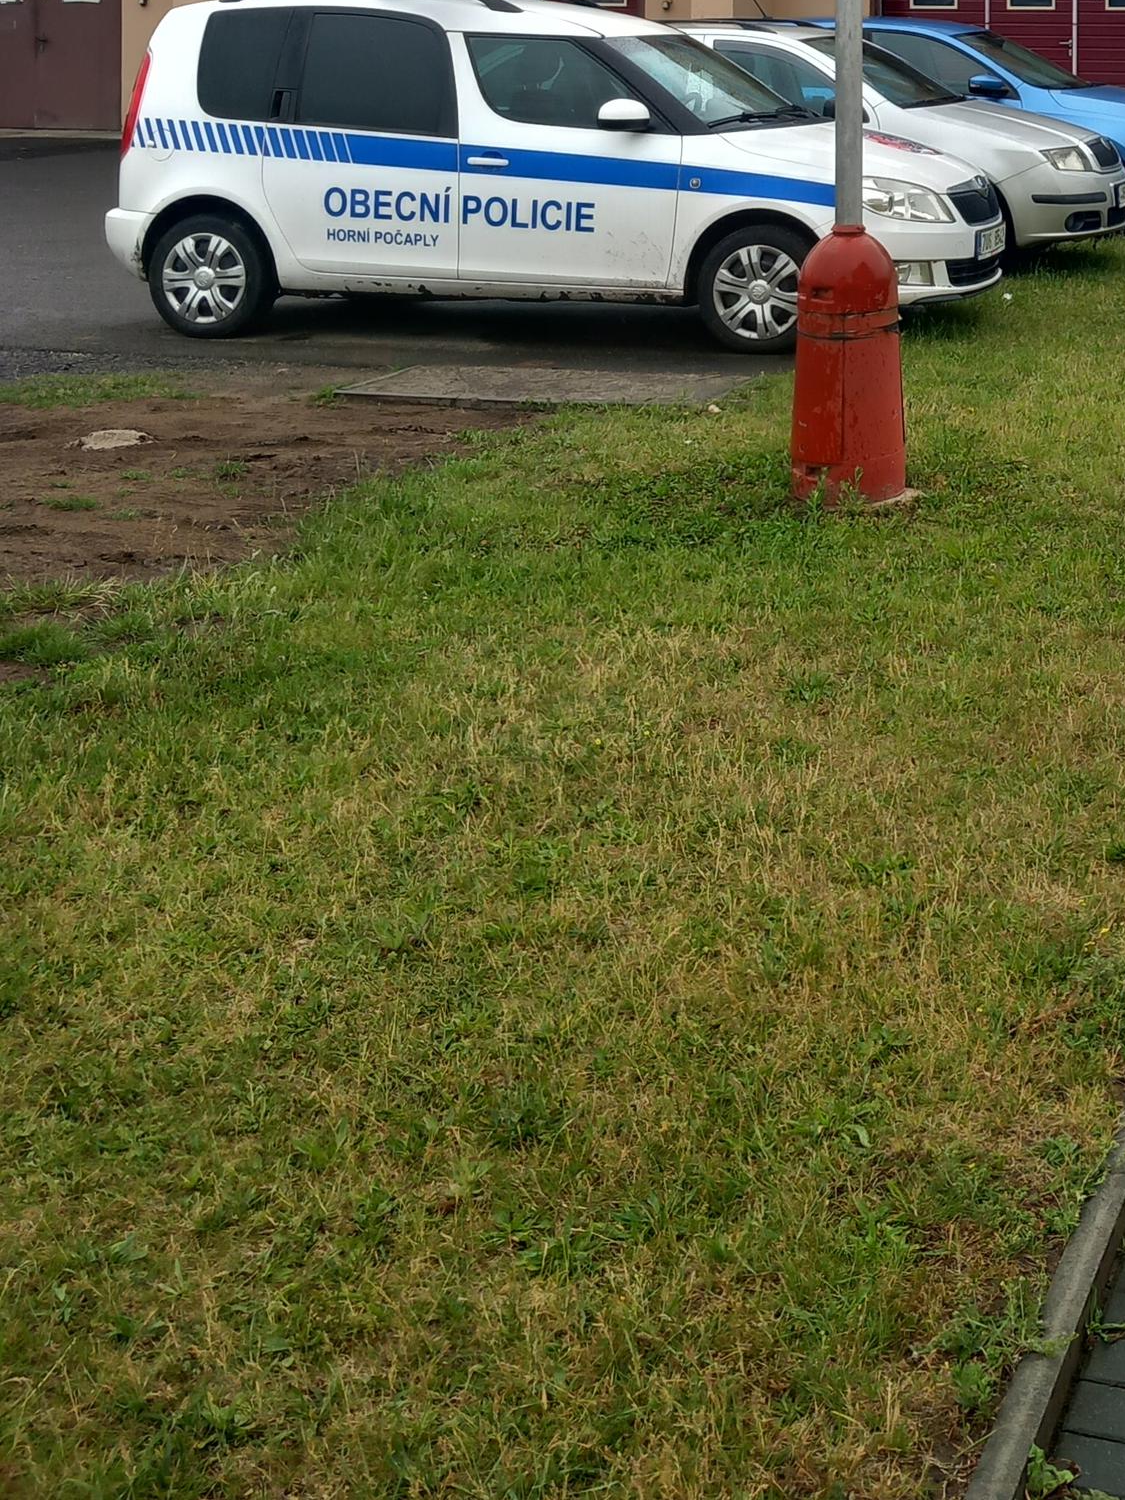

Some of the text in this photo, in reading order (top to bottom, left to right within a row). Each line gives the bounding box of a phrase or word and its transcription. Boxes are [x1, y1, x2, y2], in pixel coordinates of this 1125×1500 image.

[324, 186, 595, 233] OBECNÍ POLICIE
[327, 228, 439, 247] HORNÍ POČAPLY
